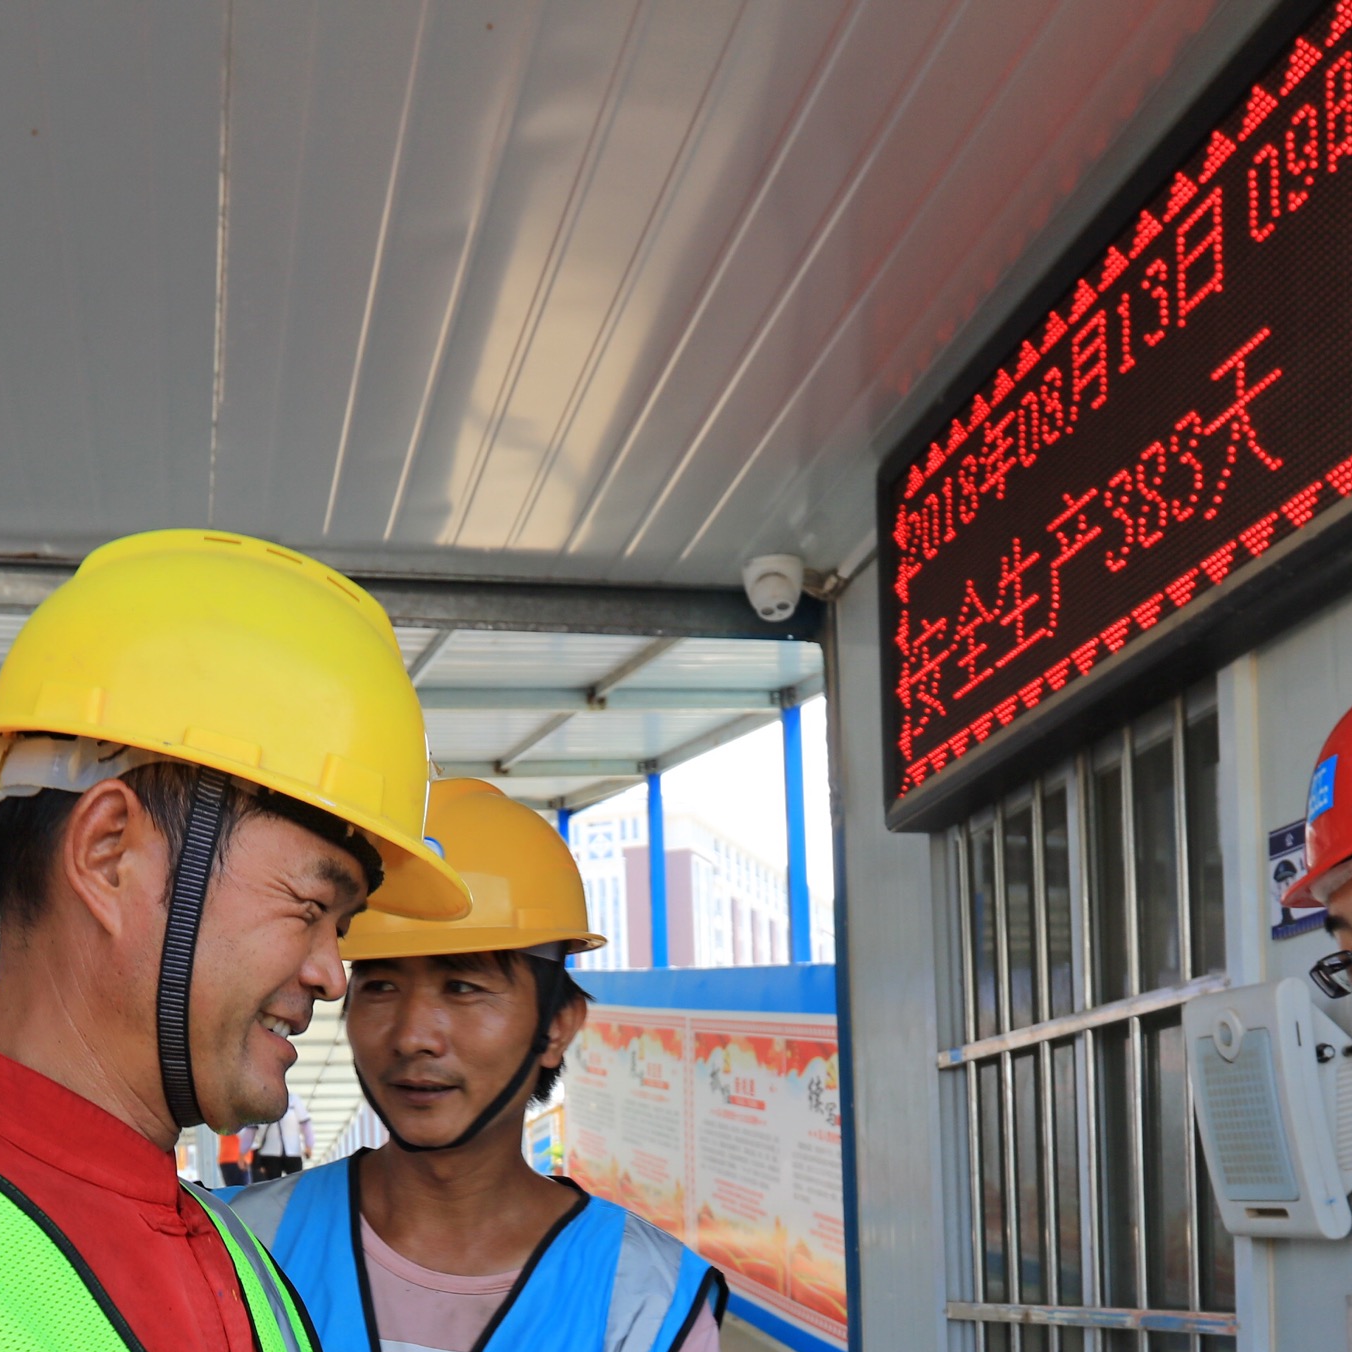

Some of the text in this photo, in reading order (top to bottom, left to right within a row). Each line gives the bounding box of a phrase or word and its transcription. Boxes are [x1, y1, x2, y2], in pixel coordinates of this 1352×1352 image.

[904, 326, 1285, 737] 安全生产383天
[905, 186, 1225, 582] 2018年08月13日
